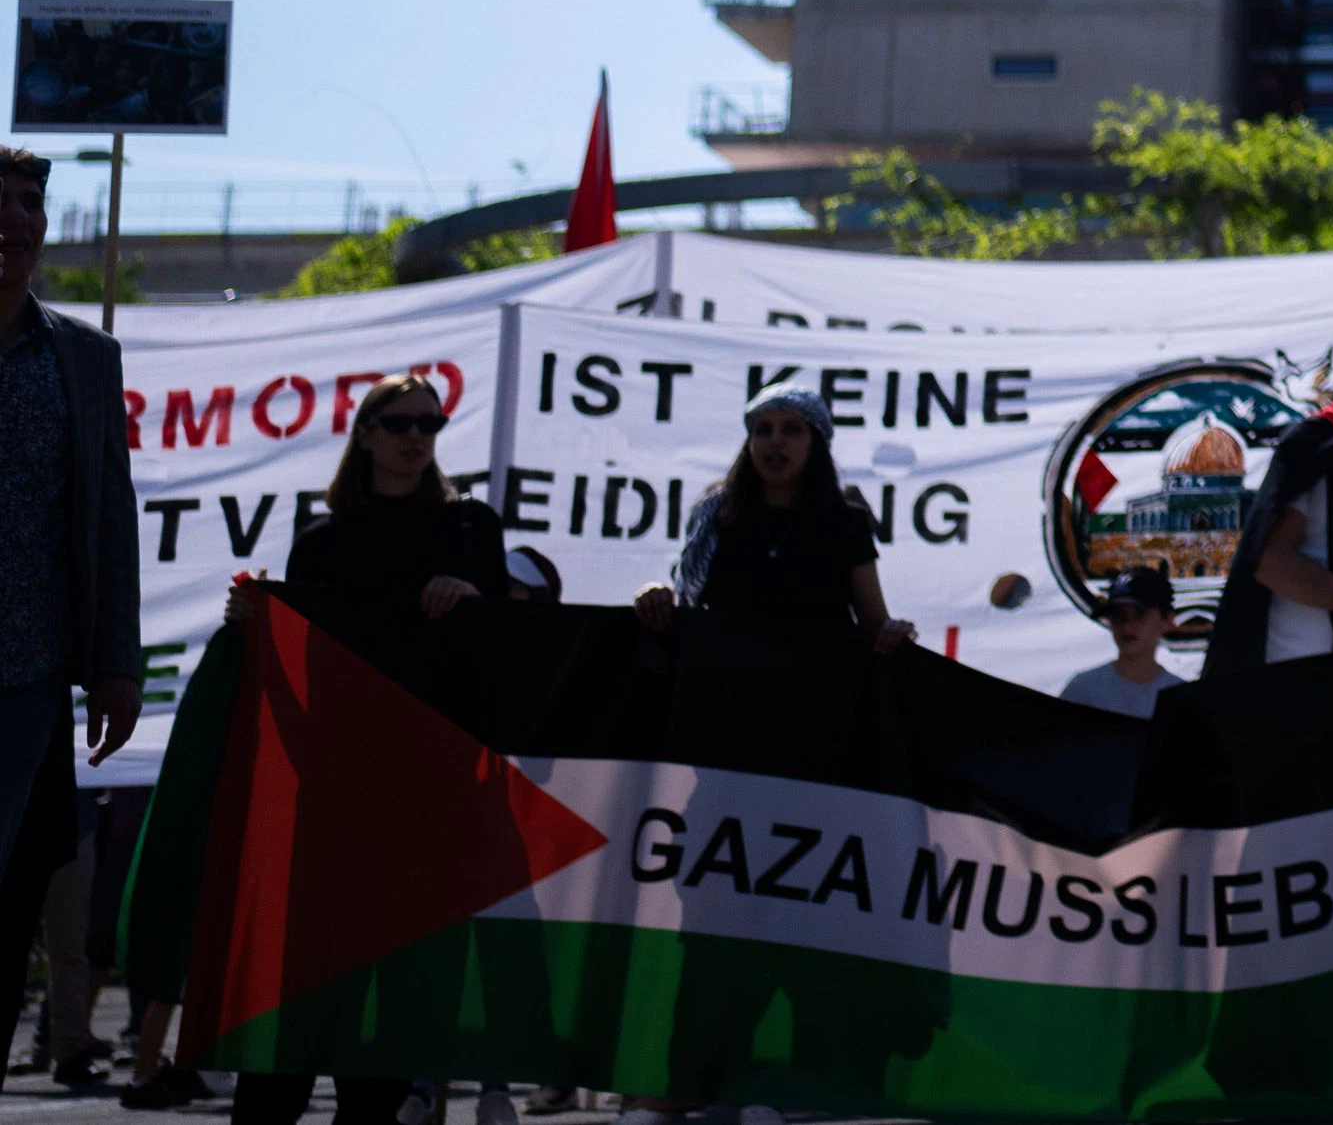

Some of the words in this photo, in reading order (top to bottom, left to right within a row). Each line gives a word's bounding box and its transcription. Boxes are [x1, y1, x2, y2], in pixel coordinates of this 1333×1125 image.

[538, 351, 694, 423] IST
[631, 807, 873, 913] GAZA
[901, 846, 1158, 947] MUSS
